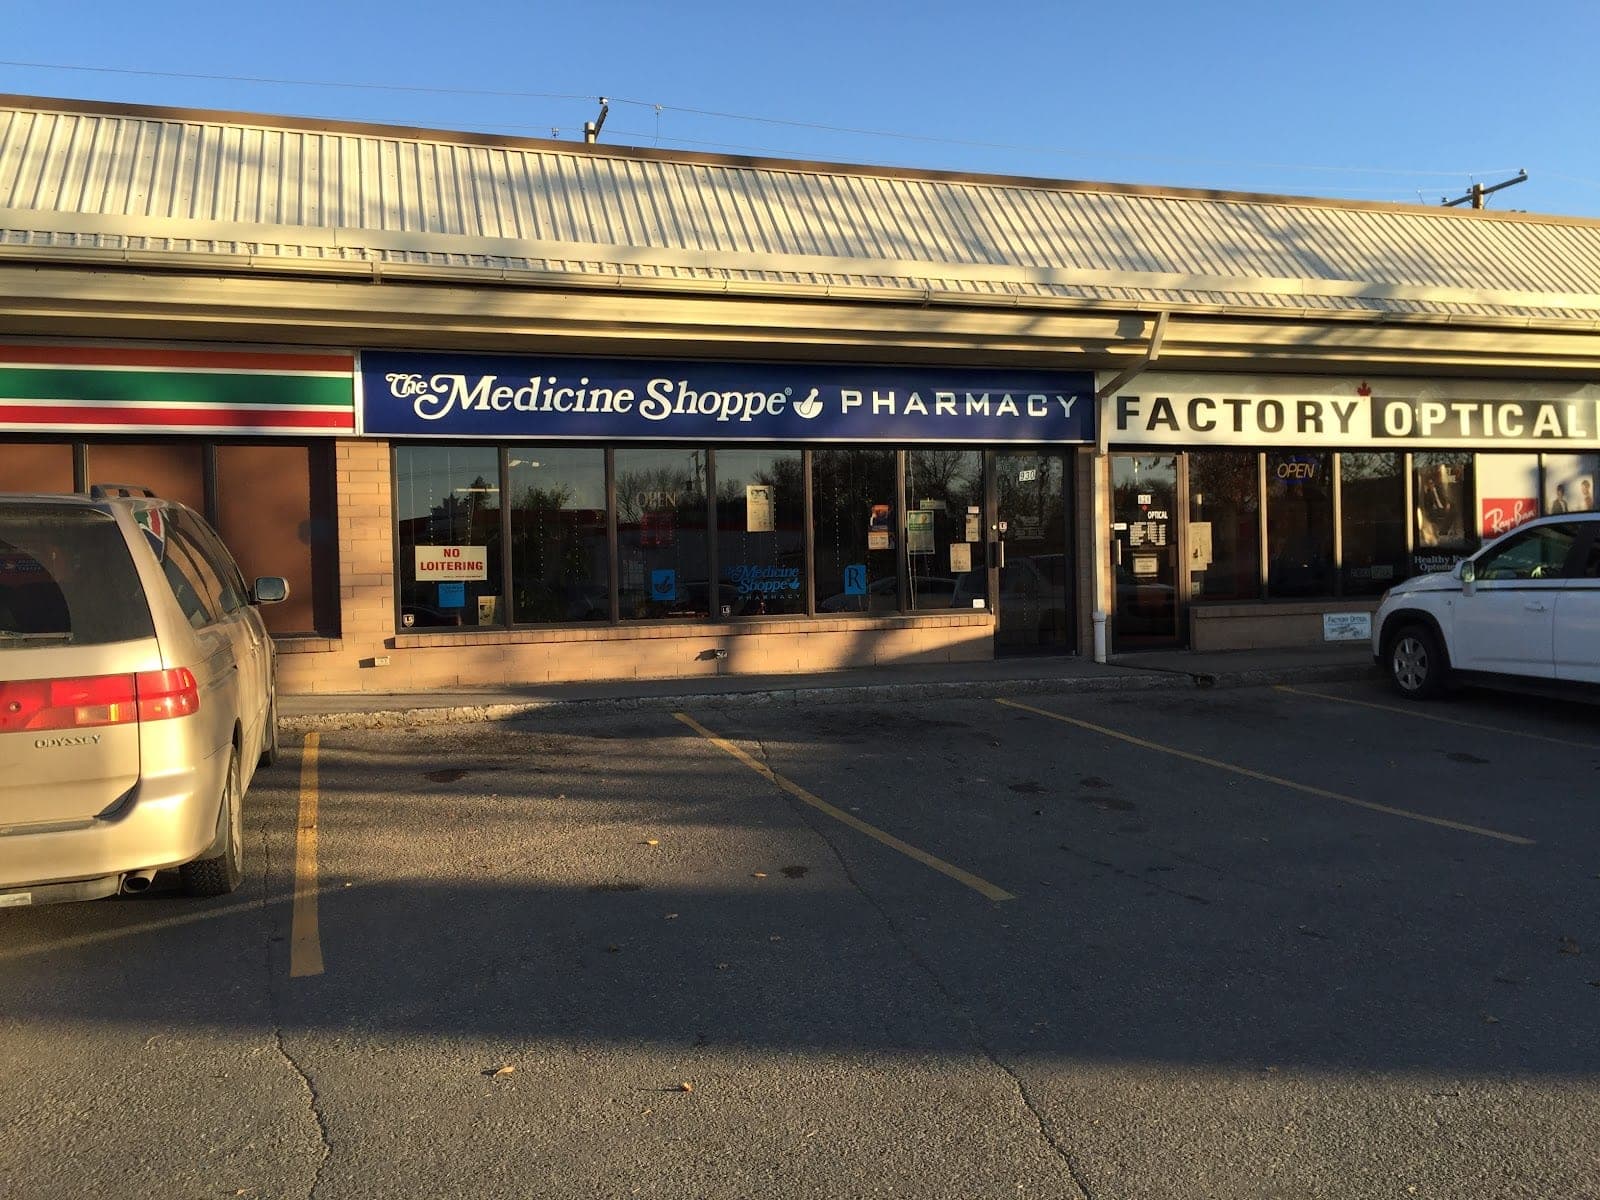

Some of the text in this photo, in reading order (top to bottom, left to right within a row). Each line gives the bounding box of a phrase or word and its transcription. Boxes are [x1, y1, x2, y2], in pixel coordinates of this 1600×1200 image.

[385, 373, 1077, 421] The Medicine Shoppe PHARMACY
[1116, 396, 1587, 437] FACTORY OPTICAL
[1020, 470, 1035, 480] 930
[1276, 463, 1315, 478] OPEN
[1147, 511, 1168, 519] OPTICAL
[1484, 500, 1536, 533] Ray-Ban
[443, 548, 460, 558] NO
[420, 561, 483, 571] LOITERING
[1414, 555, 1450, 566] Healthy
[34, 735, 101, 748] ODYSSEY
